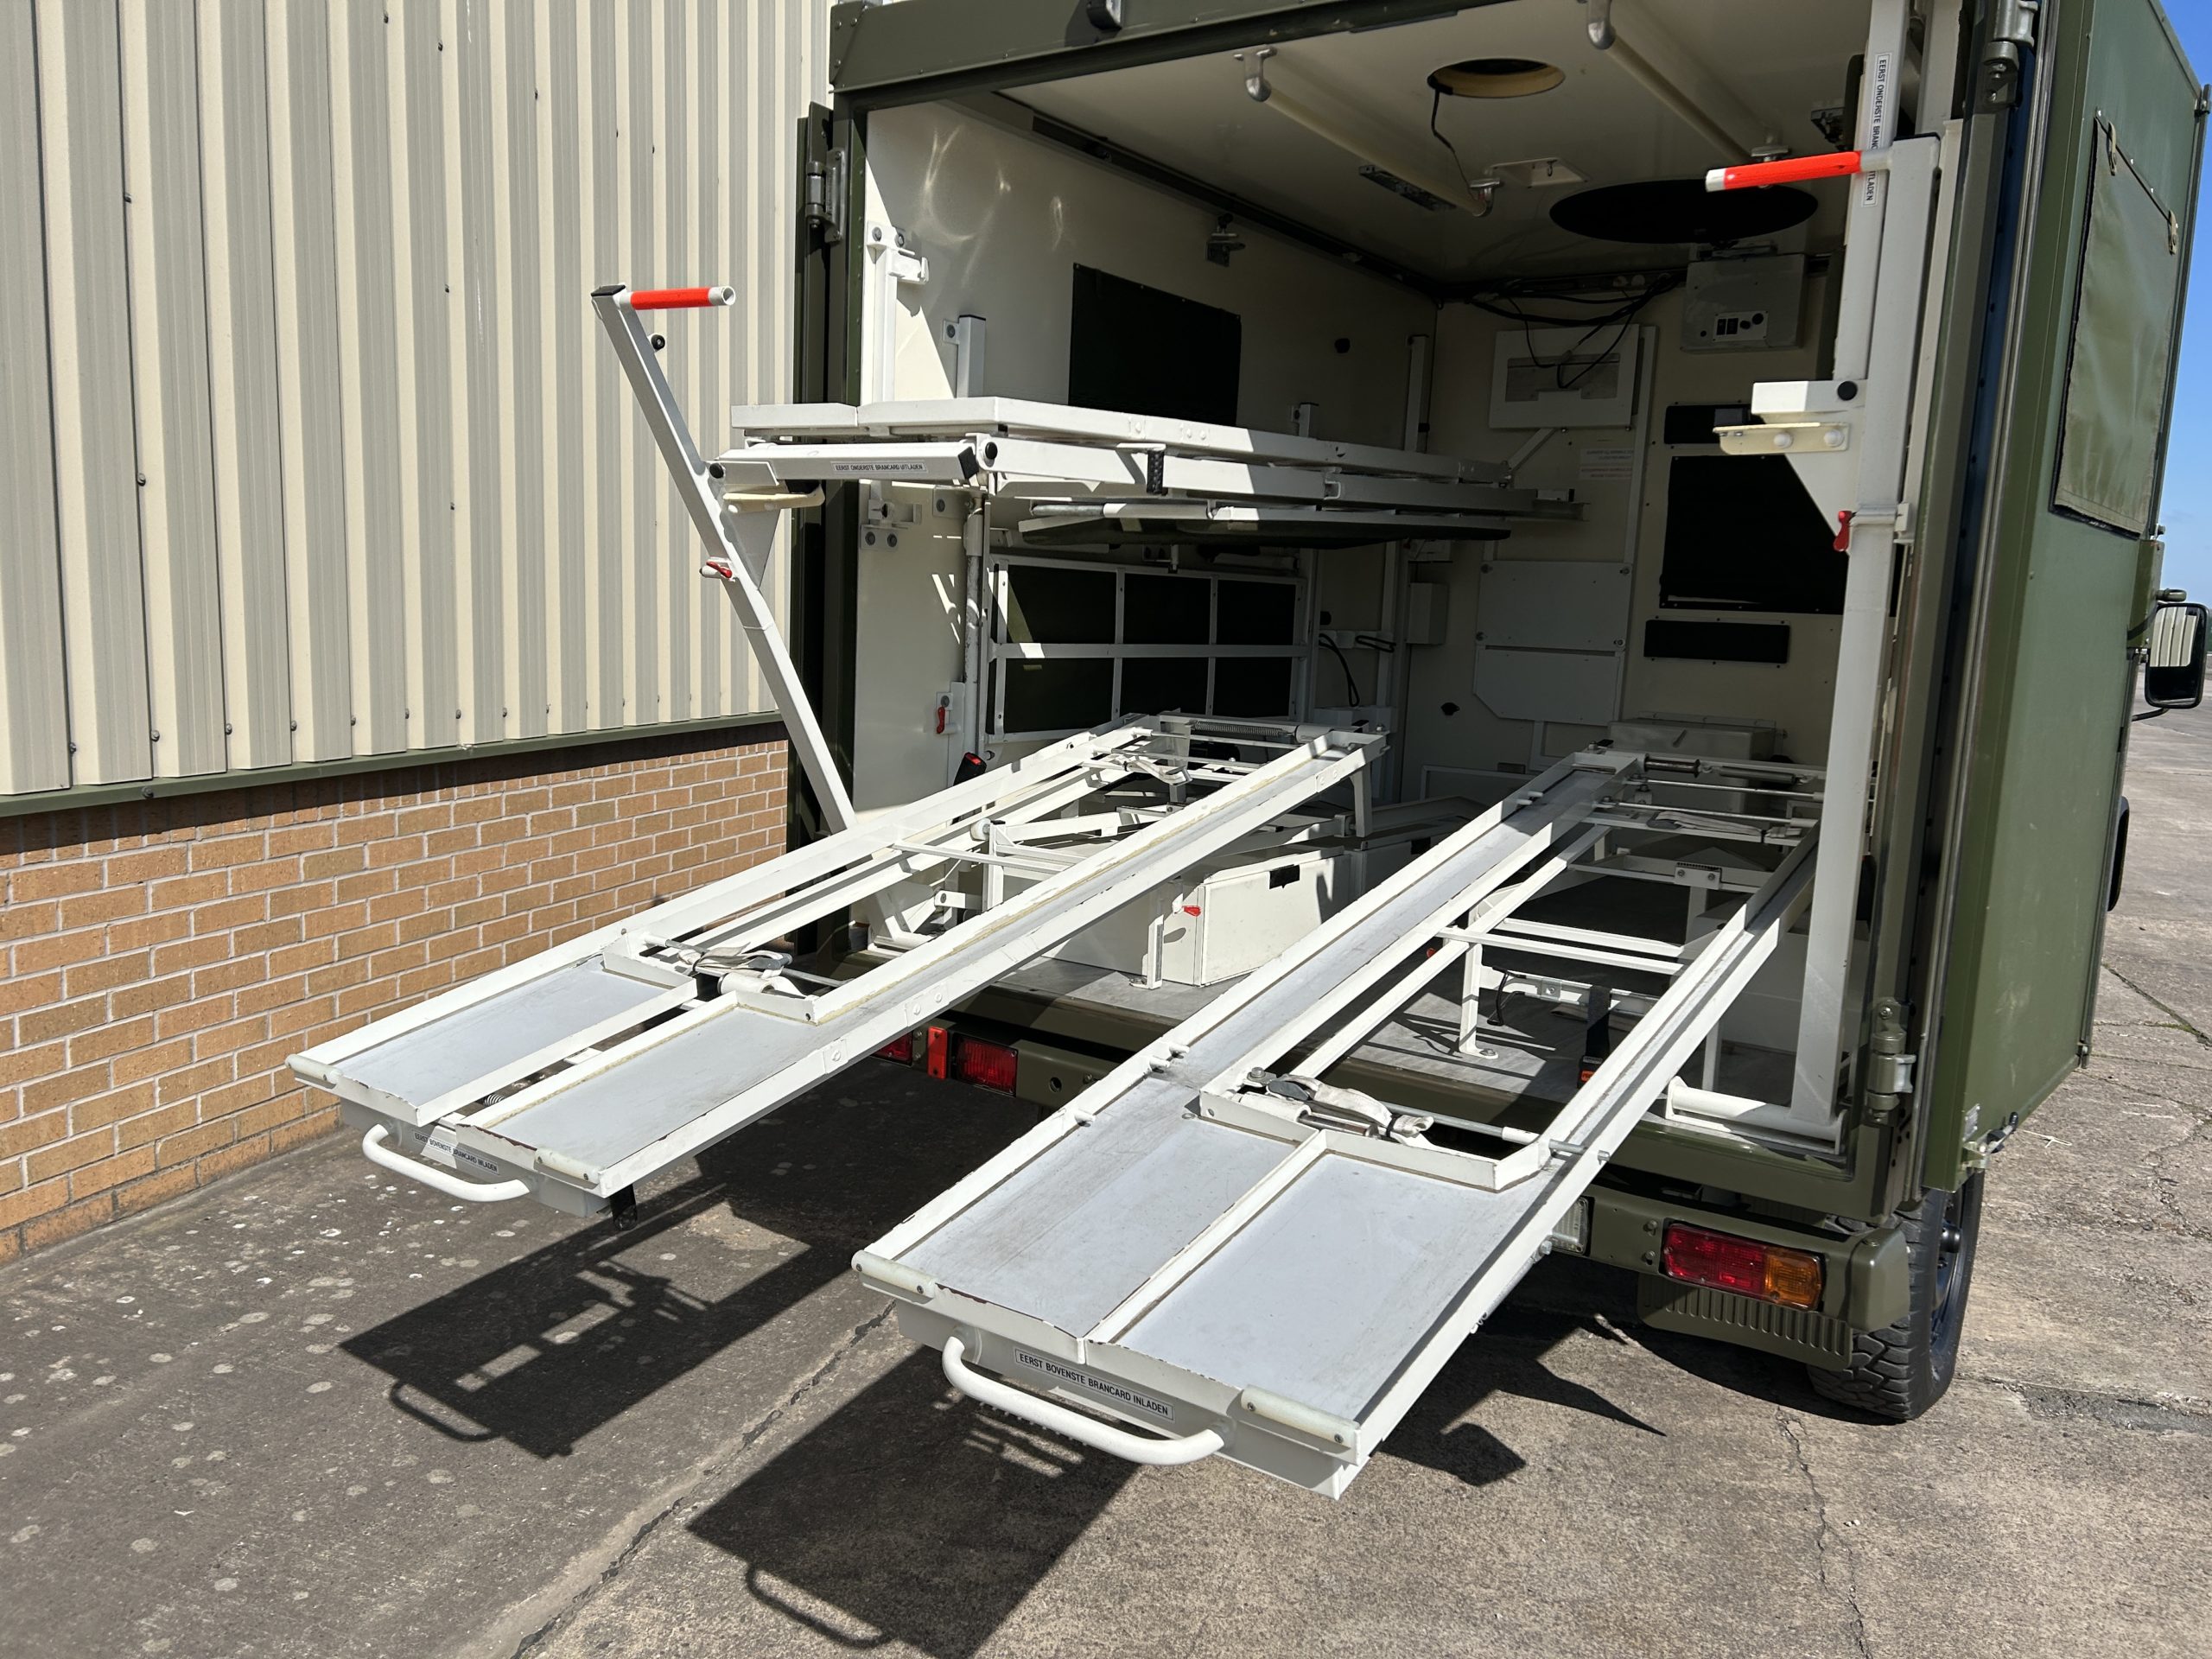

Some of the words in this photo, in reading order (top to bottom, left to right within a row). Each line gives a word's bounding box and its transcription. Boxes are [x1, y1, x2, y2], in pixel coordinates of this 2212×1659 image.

[1878, 59, 1887, 82] EERST
[1873, 84, 1885, 124] ONDERSTE
[1871, 125, 1880, 150] BRANC
[1866, 170, 1876, 201] ITLADEN
[429, 1138, 452, 1154] BOVENSTE
[453, 1148, 478, 1164] BRANCARD
[478, 1159, 498, 1173] INLADEN
[1020, 1353, 1043, 1369] EERST
[1046, 1363, 1086, 1384] BOVENSTE
[1088, 1378, 1131, 1402] BRANCARD
[1133, 1395, 1168, 1415] INLADEN
